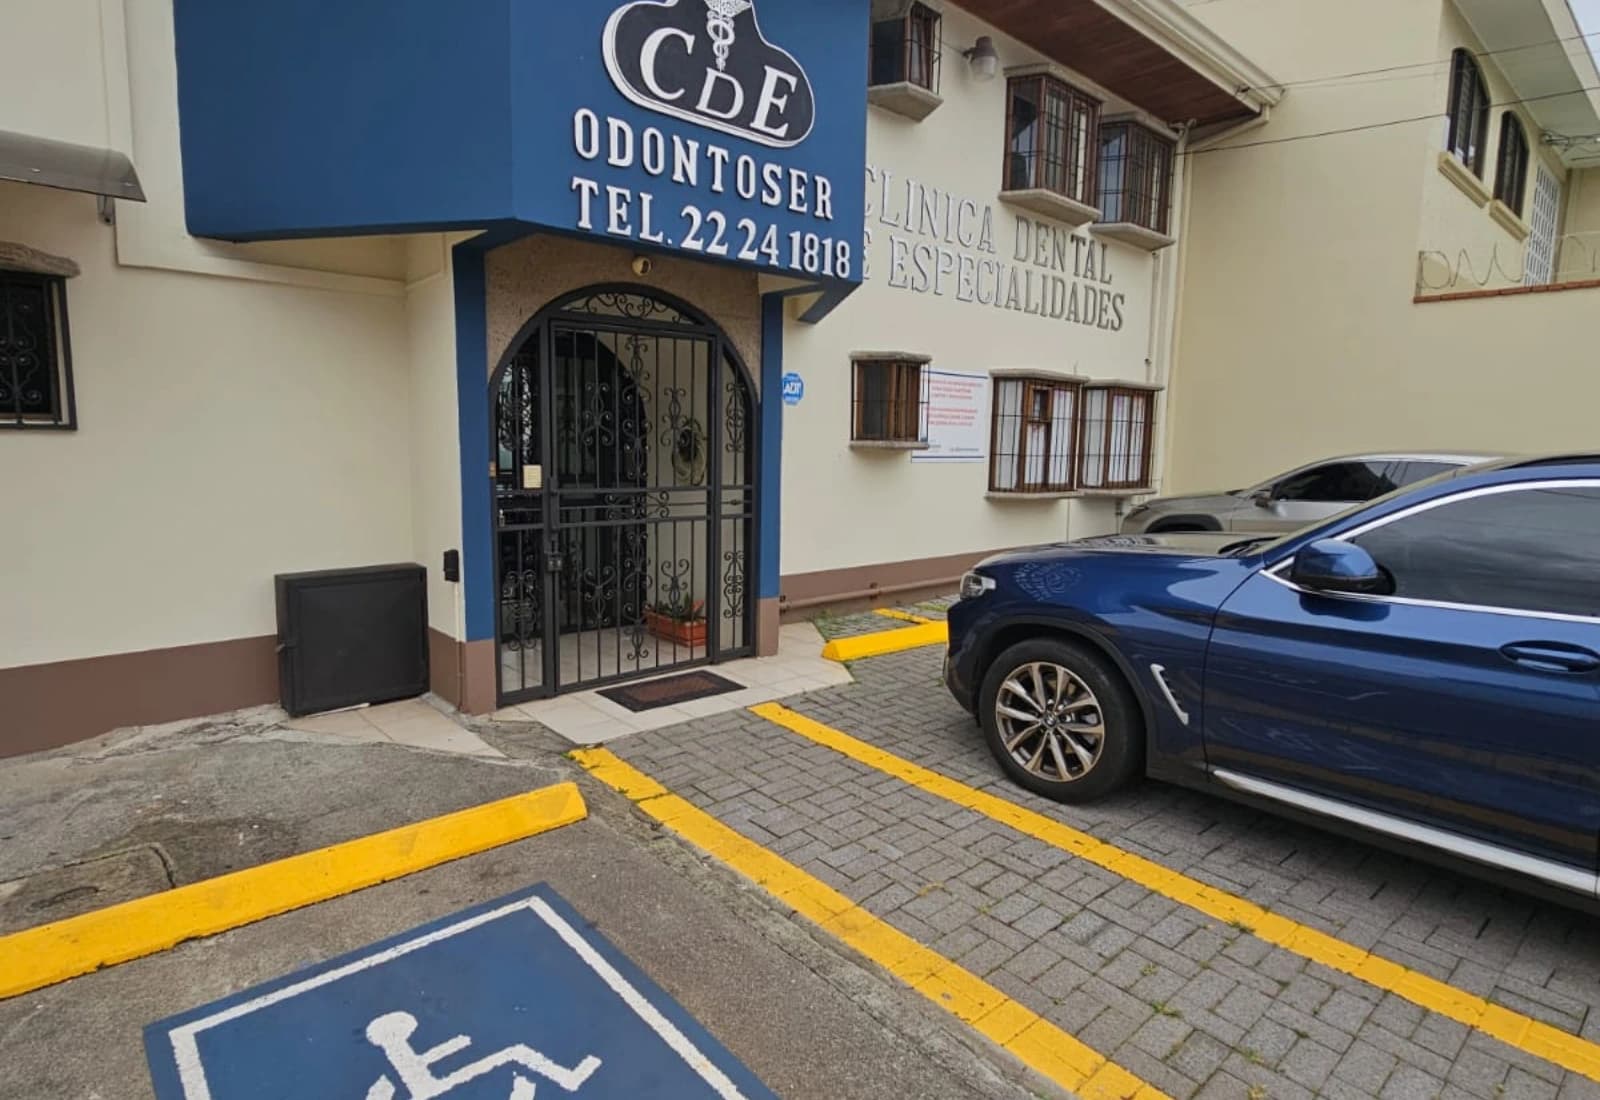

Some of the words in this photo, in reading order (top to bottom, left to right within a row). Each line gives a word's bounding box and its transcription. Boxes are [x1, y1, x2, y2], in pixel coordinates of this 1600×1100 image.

[640, 27, 798, 138] CDE
[573, 108, 833, 220] ODONTOSER
[571, 176, 672, 244] TEL.
[788, 230, 851, 279] 1818
[1013, 214, 1113, 285] DENTAL
[888, 235, 1125, 332] ESPECIALIDADES
